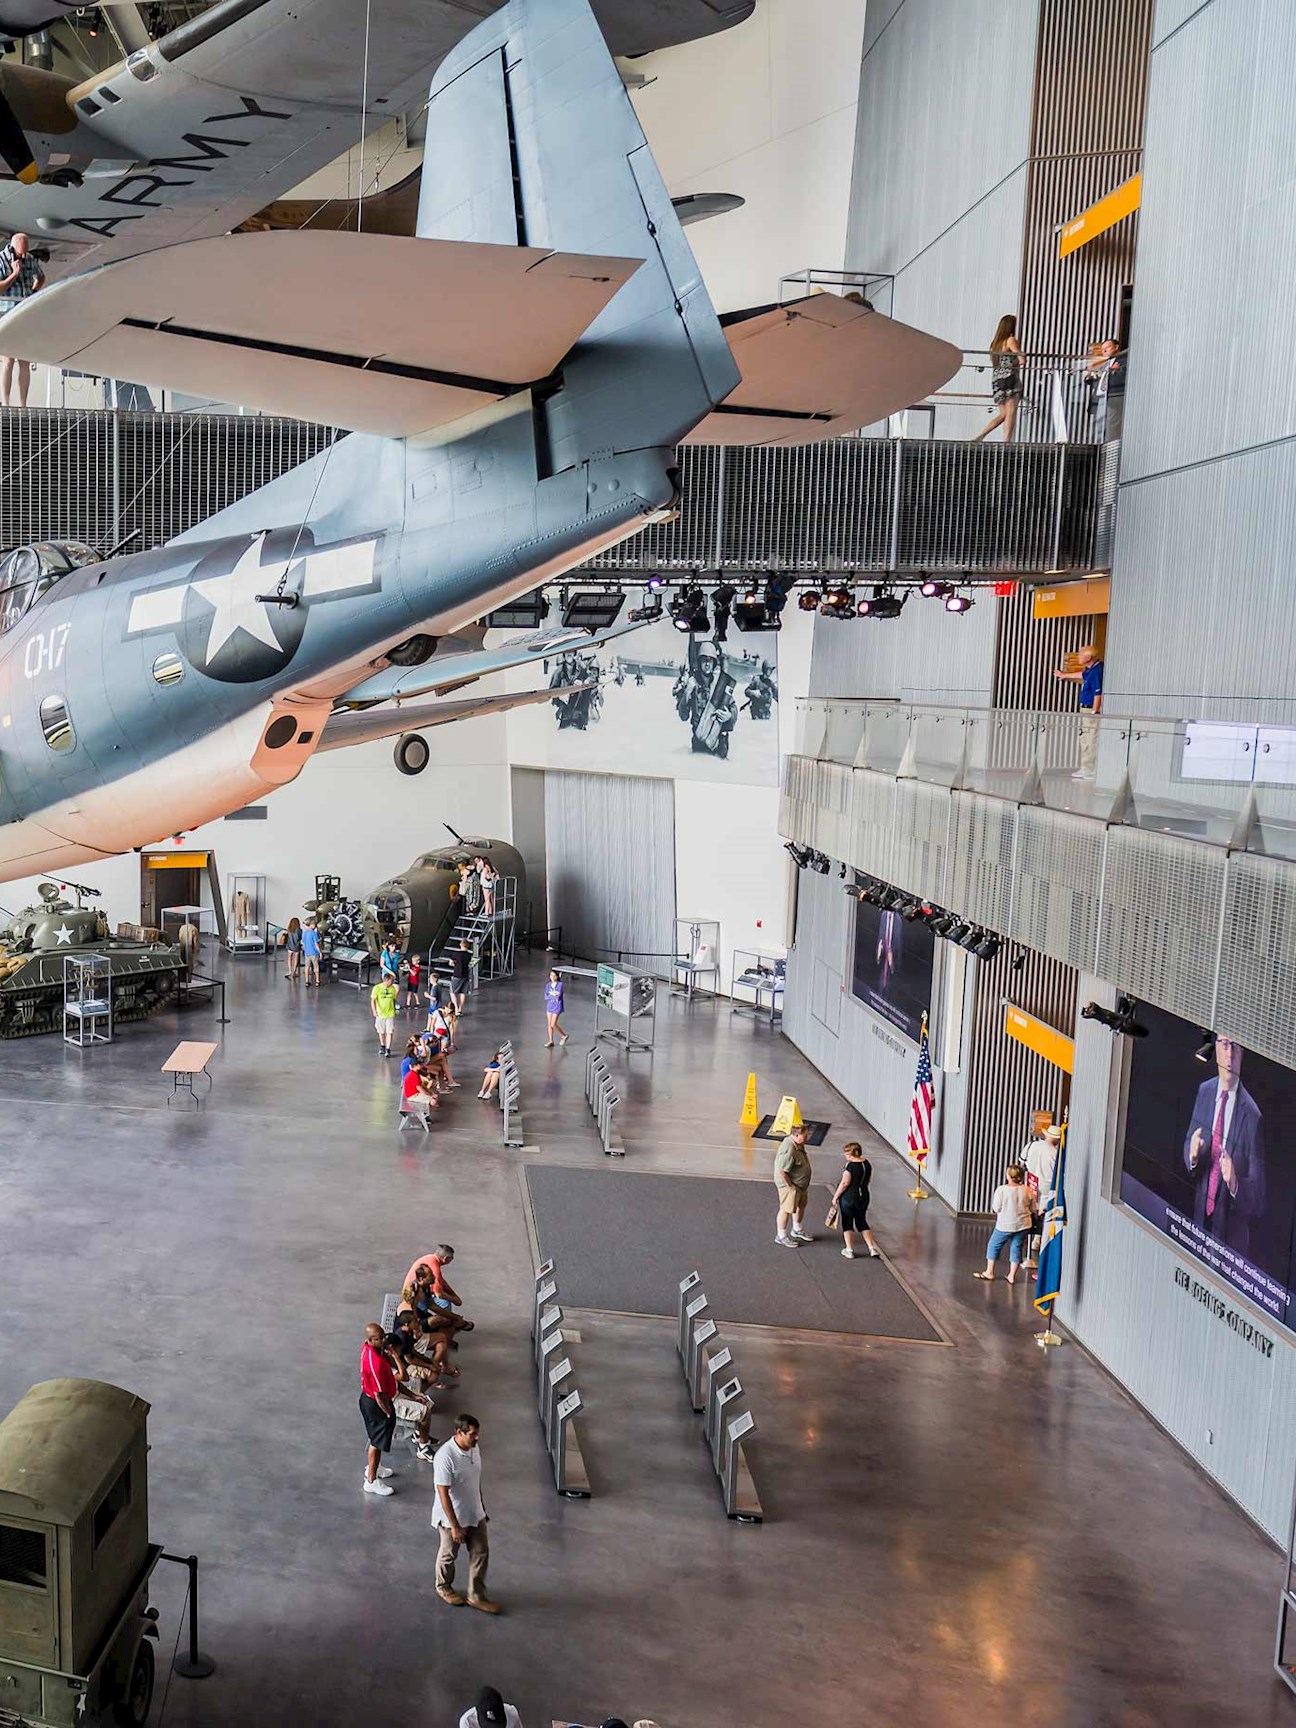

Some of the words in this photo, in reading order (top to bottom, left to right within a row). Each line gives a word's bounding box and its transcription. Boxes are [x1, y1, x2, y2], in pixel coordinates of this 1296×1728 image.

[68, 96, 293, 238] ARMY
[1170, 1224, 1179, 1236] the
[1179, 1229, 1197, 1250] lessons
[1197, 1244, 1203, 1254] of
[1202, 1247, 1211, 1260] the
[1211, 1255, 1222, 1267] war
[1221, 1261, 1232, 1277] that
[1231, 1270, 1254, 1293] changed
[1254, 1286, 1264, 1300] the
[1263, 1294, 1280, 1313] world.
[1182, 1217, 1192, 1232] that
[1192, 1223, 1206, 1241] future
[1205, 1236, 1235, 1263] generations
[1235, 1256, 1244, 1270] will
[1244, 1264, 1267, 1287] continue
[1175, 1267, 1190, 1291] THE
[1226, 1310, 1274, 1358] COMPANY
